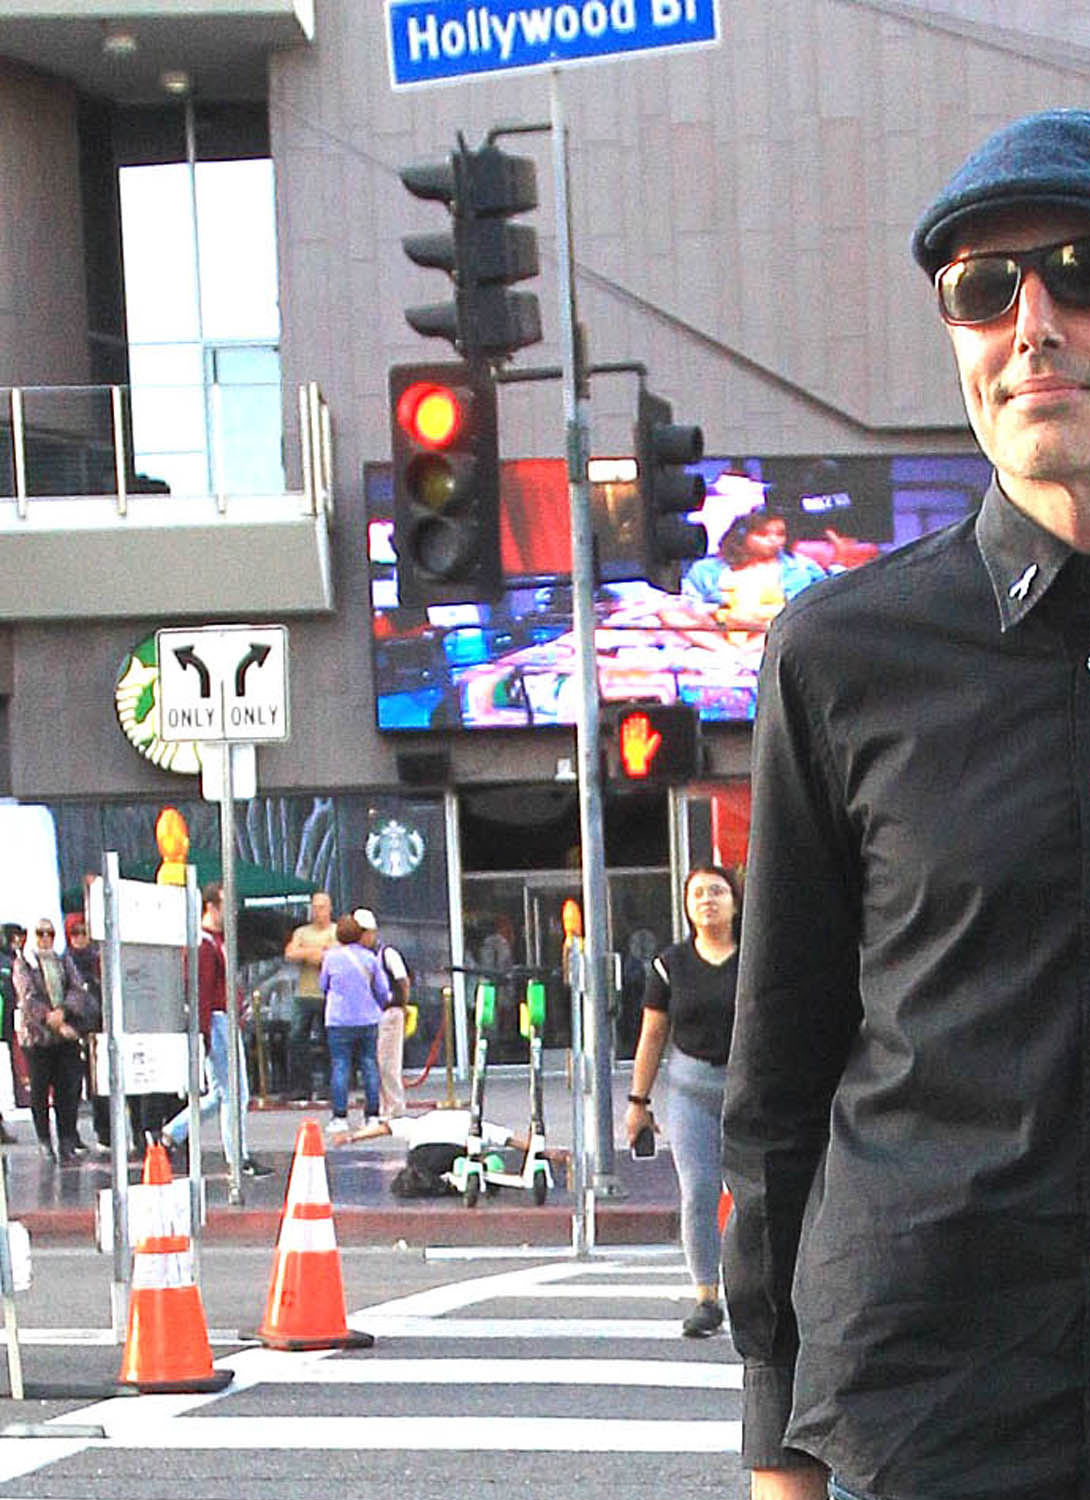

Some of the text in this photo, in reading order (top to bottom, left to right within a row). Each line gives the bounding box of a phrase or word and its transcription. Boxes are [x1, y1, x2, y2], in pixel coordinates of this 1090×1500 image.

[407, 0, 636, 62] Hollywood
[168, 704, 279, 728] ONLY ONLY
